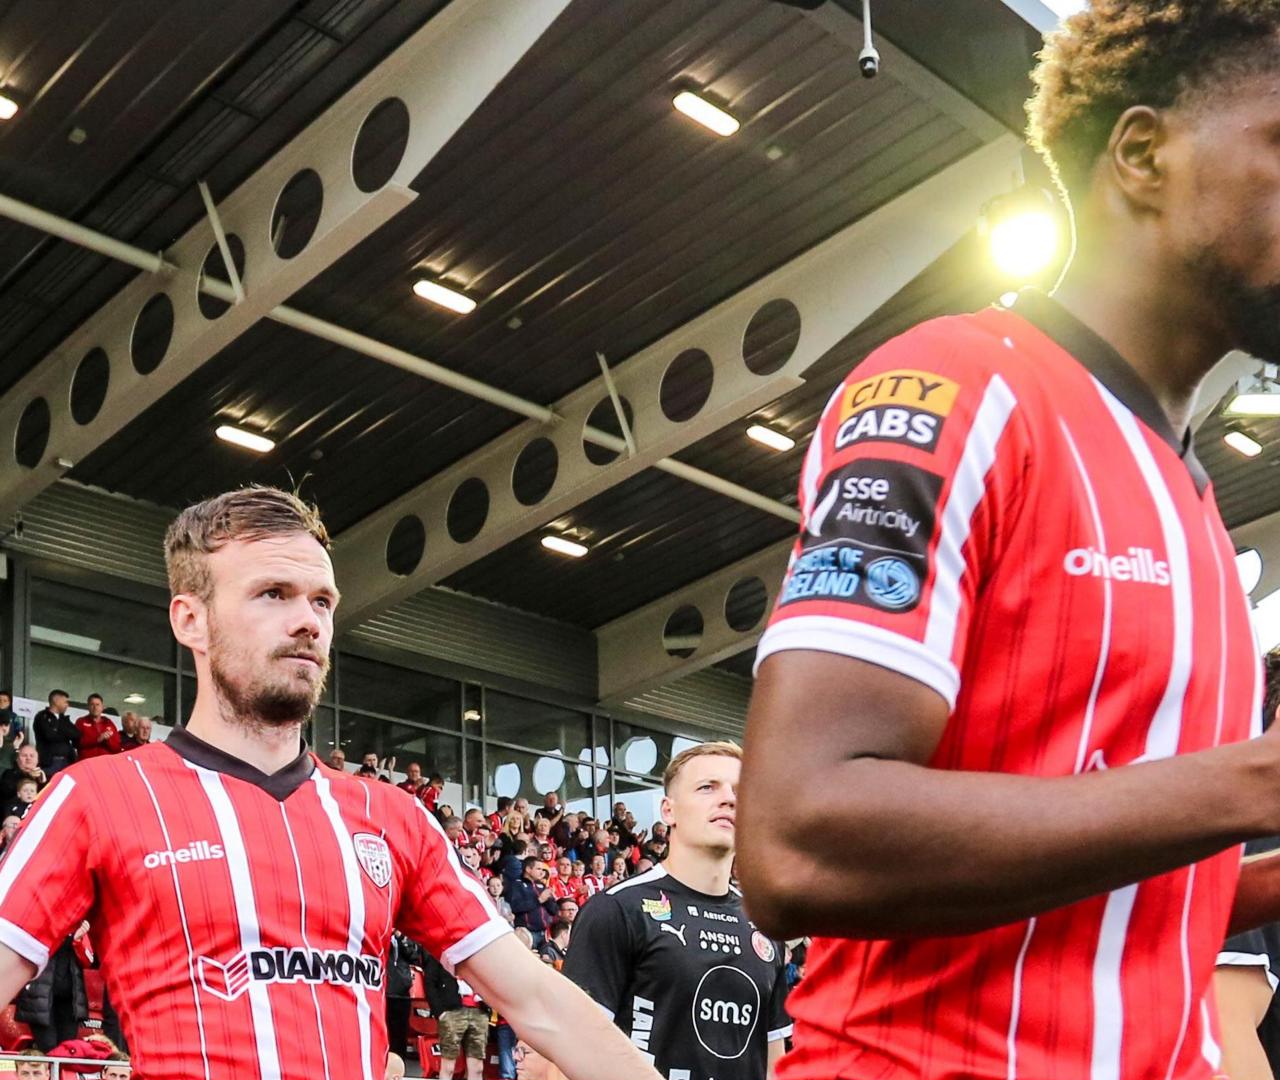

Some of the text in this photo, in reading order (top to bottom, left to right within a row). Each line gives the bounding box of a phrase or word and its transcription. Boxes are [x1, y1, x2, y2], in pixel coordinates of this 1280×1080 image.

[852, 375, 943, 409] CITY
[835, 408, 937, 448] CABS
[842, 477, 890, 501] sse
[836, 502, 921, 538] Airtricity
[699, 930, 740, 946] ANSNI
[250, 950, 383, 988] DIAMOND
[700, 998, 753, 1026] sms
